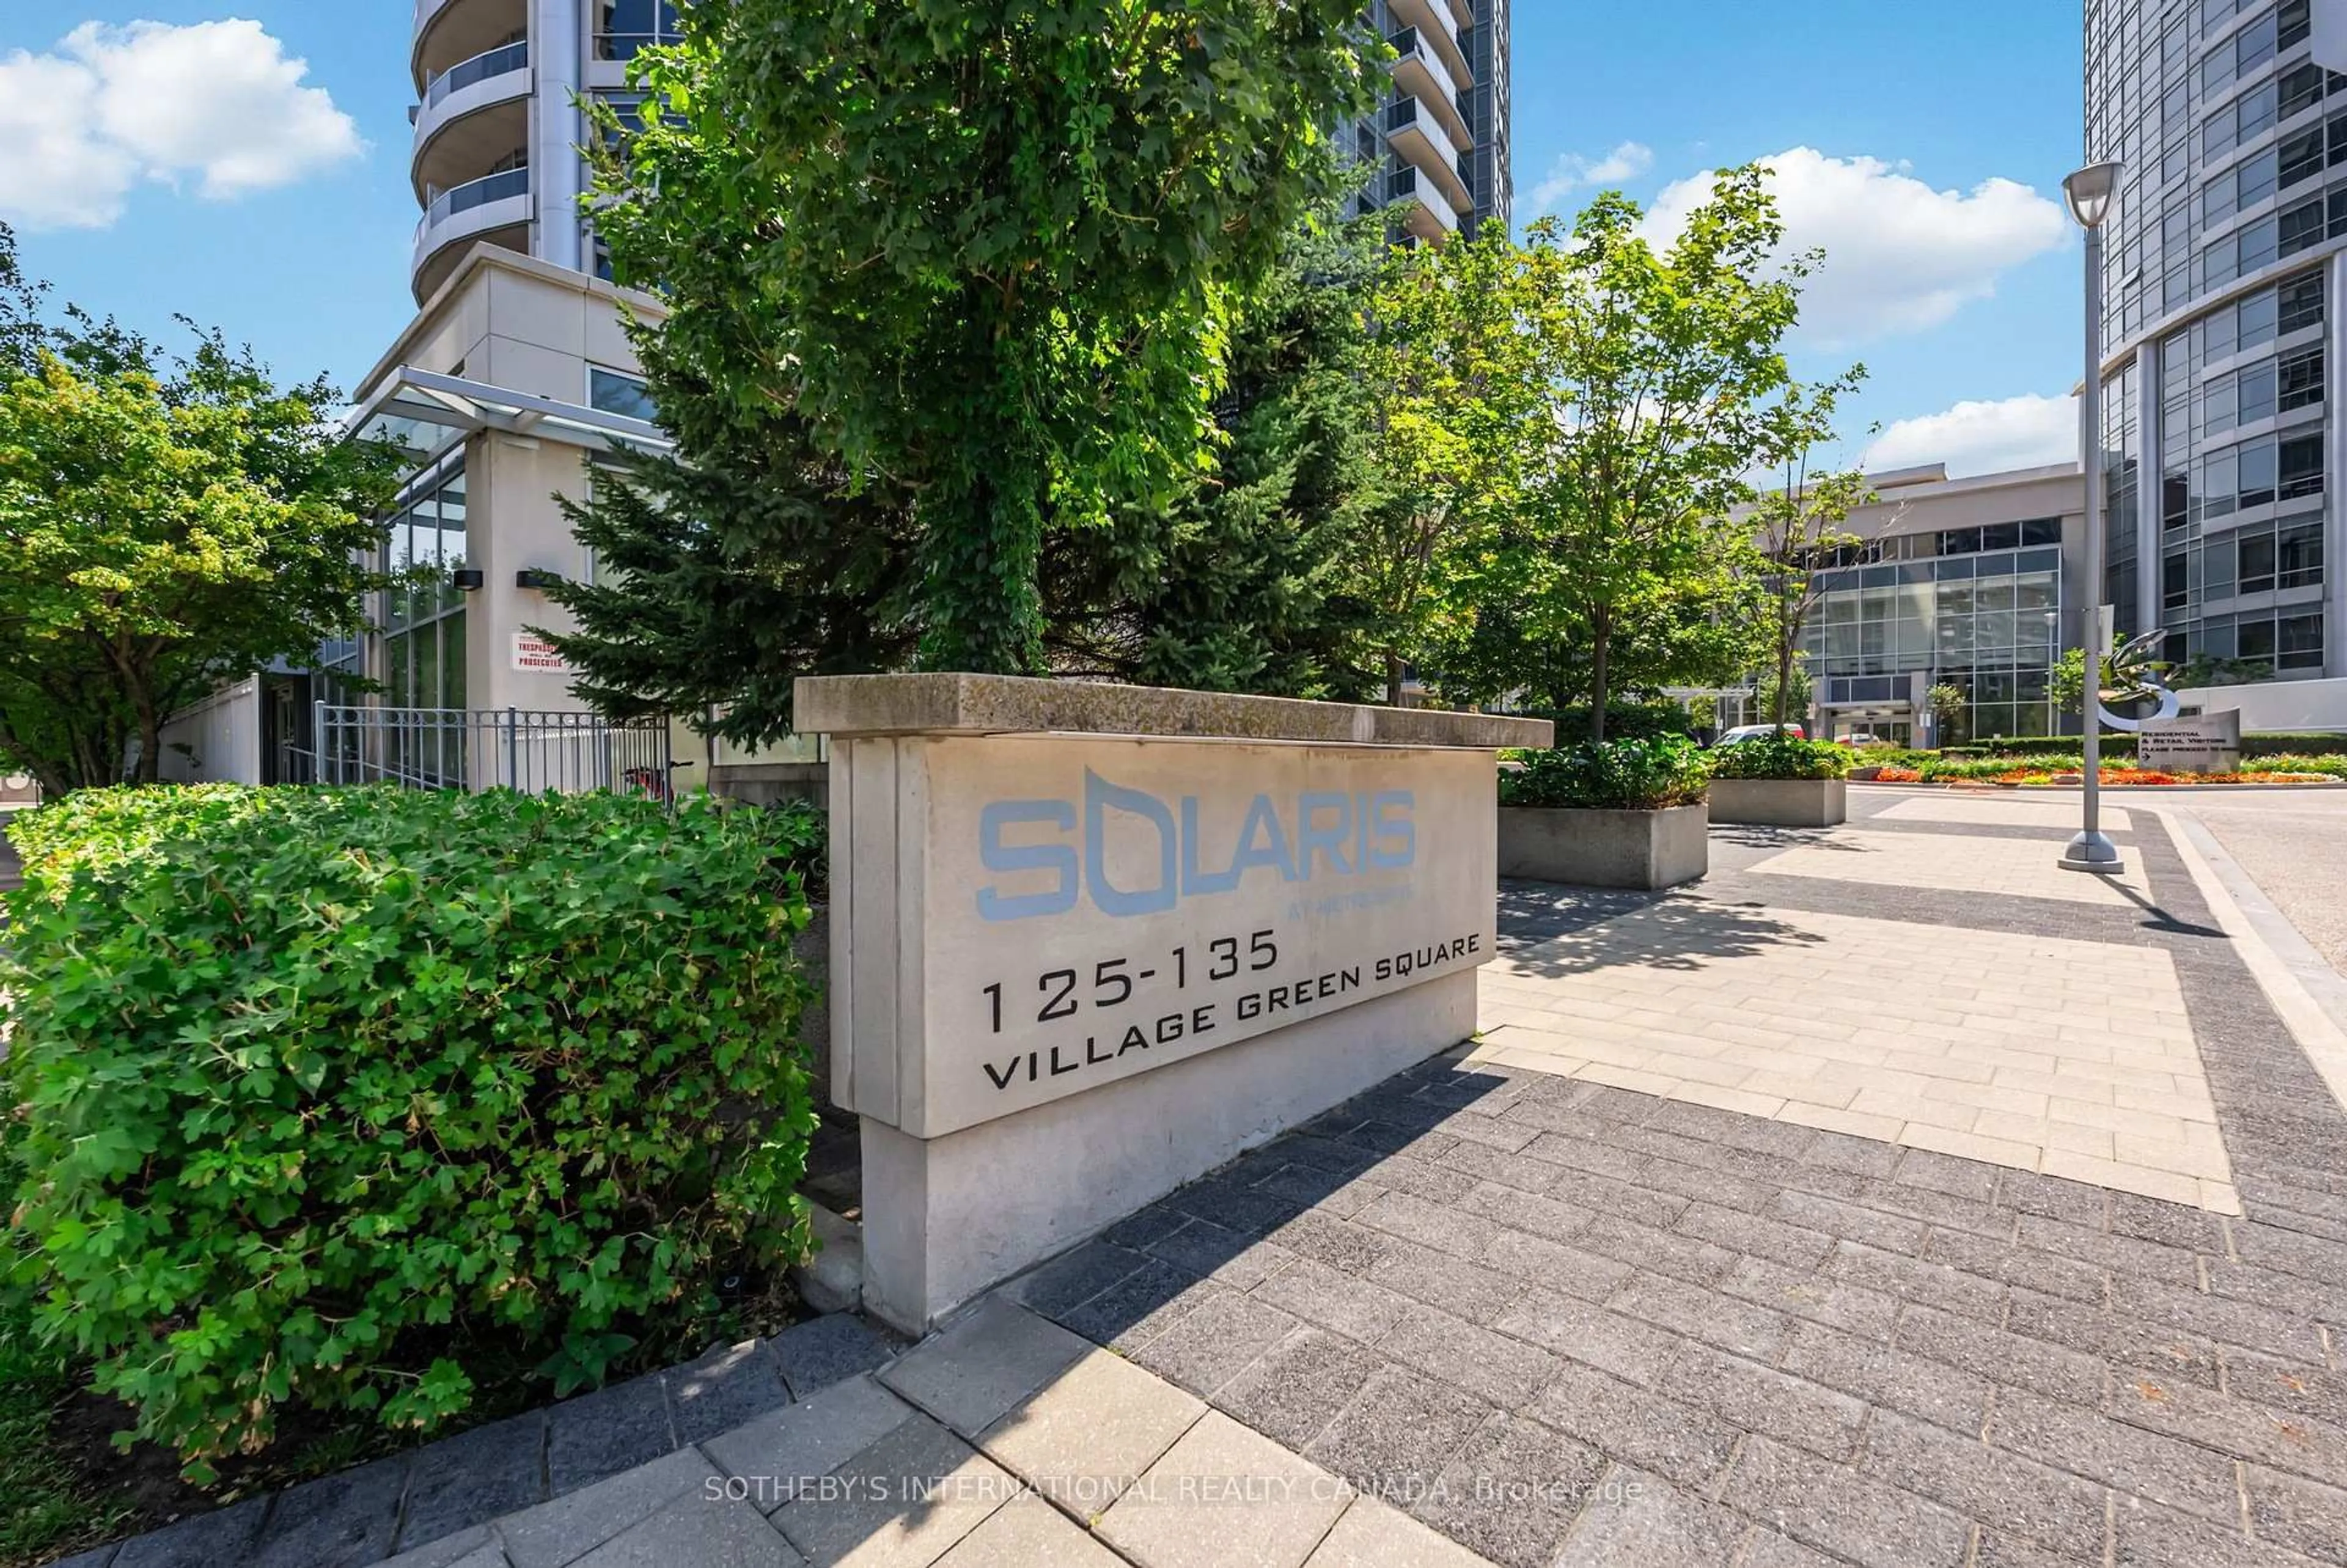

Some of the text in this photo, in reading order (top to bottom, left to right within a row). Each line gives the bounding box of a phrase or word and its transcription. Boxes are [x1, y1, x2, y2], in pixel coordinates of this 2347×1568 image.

[519, 643, 559, 652] TRESPASSE
[520, 658, 562, 667] PROSECUTED
[977, 764, 1414, 921] SOLARIS
[983, 929, 1277, 1033] 125-135
[983, 933, 1480, 1090] VILLAGE GREEN SQUARE
